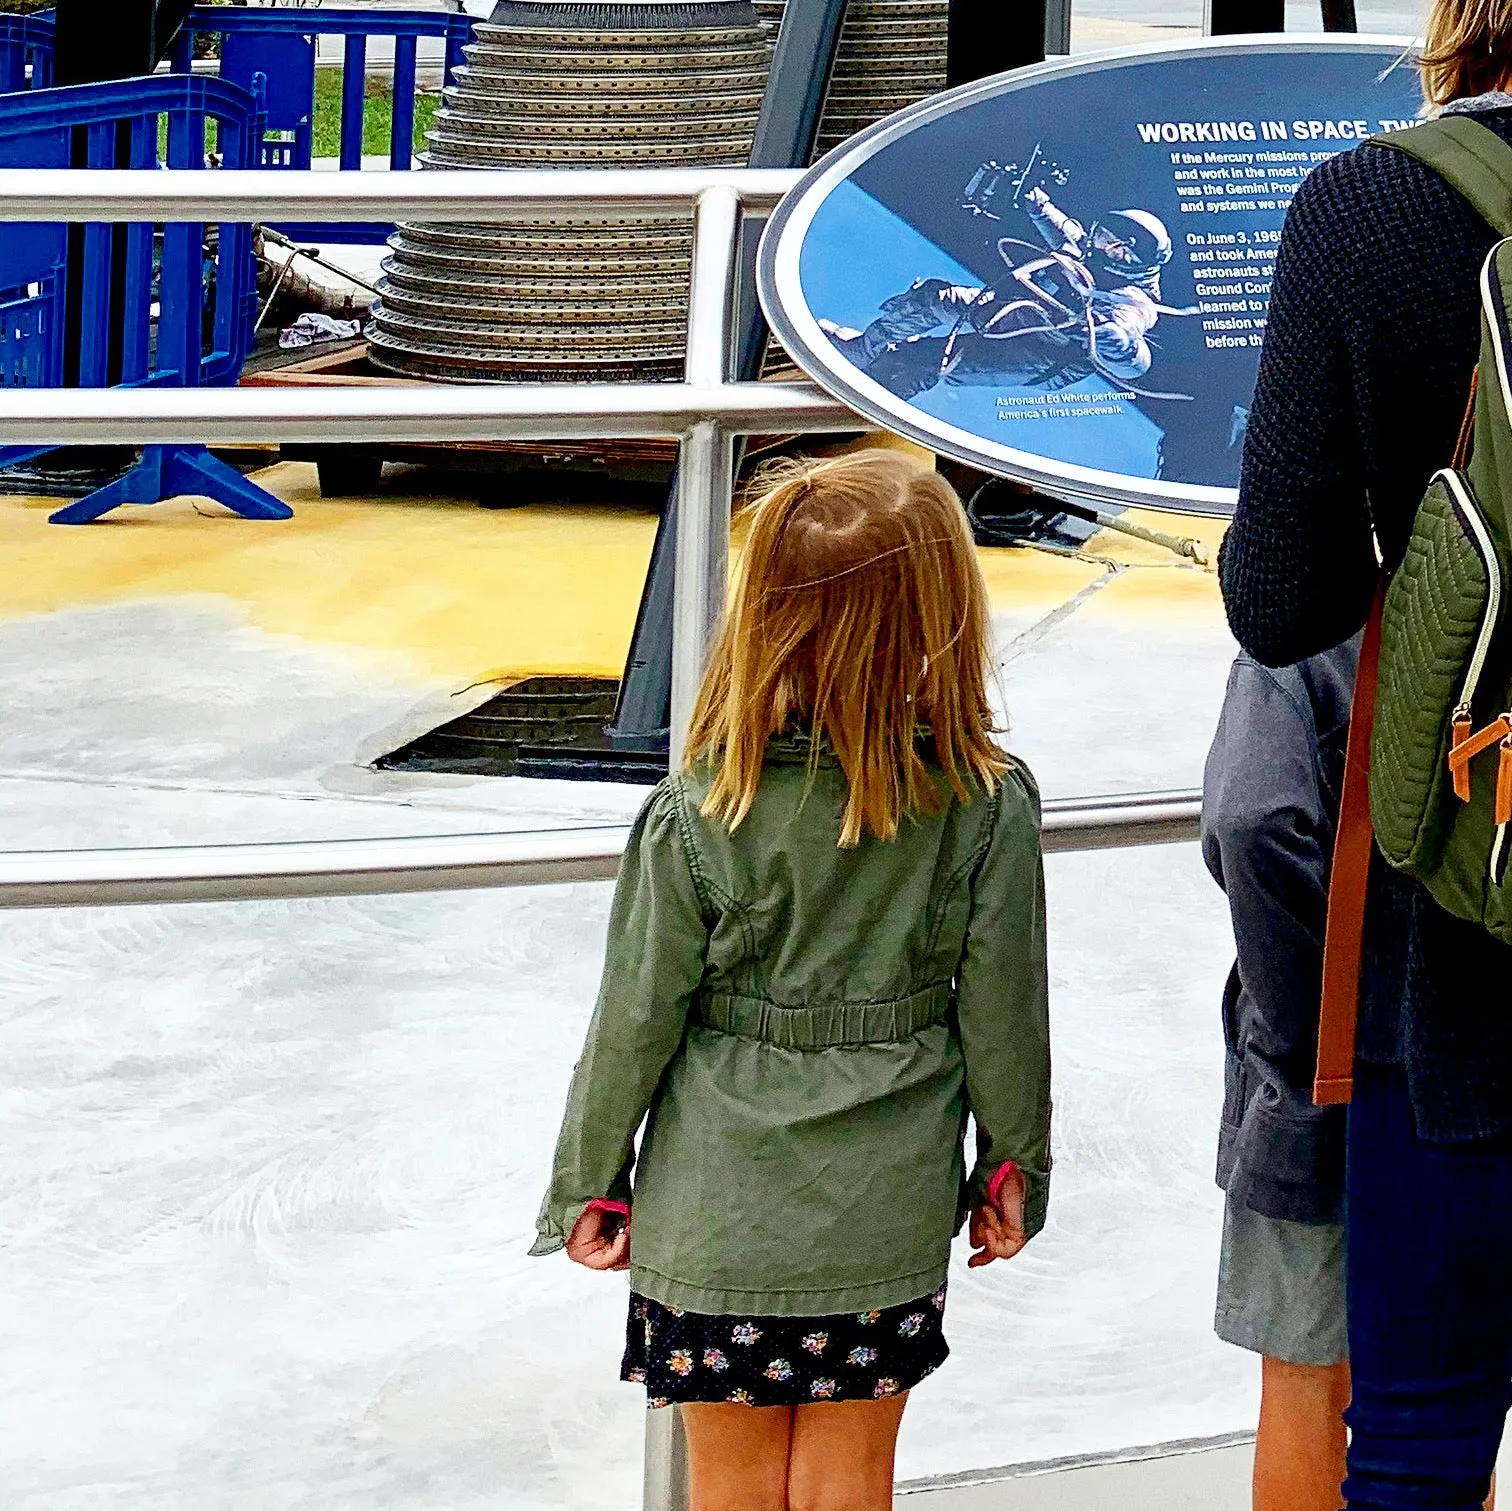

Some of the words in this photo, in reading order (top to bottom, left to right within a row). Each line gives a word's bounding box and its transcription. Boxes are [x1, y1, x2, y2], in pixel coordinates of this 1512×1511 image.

[1136, 121, 1257, 143] WORKING
[1260, 120, 1288, 141] IN
[1170, 152, 1181, 164] If
[1181, 152, 1203, 164] the
[1203, 151, 1254, 165] Mercury
[1255, 150, 1309, 163] missions
[1309, 151, 1341, 164] prov
[1174, 168, 1198, 180] and
[1199, 167, 1231, 180] work
[1231, 167, 1244, 179] in
[1245, 167, 1265, 178] the
[1267, 166, 1299, 178] most
[1176, 186, 1202, 196] was
[1202, 184, 1224, 196] the
[1225, 182, 1270, 195] Gemini
[1180, 200, 1204, 213] and
[1206, 199, 1257, 214] systems
[1257, 200, 1276, 210] we
[1186, 233, 1206, 245] On
[1206, 232, 1236, 245] June
[1236, 231, 1252, 245] 3,
[1189, 249, 1214, 262] and
[1215, 248, 1246, 261] took
[1193, 265, 1260, 279] astronauts
[1195, 282, 1243, 296] Ground
[1199, 299, 1248, 313] learned
[1248, 299, 1263, 311] to
[1202, 317, 1253, 331] mission
[1205, 334, 1248, 349] before
[996, 394, 1045, 407] Astronaut
[1046, 393, 1060, 405] Ed
[1060, 392, 1092, 404] White
[1092, 390, 1137, 404] performs
[998, 409, 1048, 421] America's
[1048, 407, 1070, 418] first
[1071, 405, 1125, 418] spacewalk.
